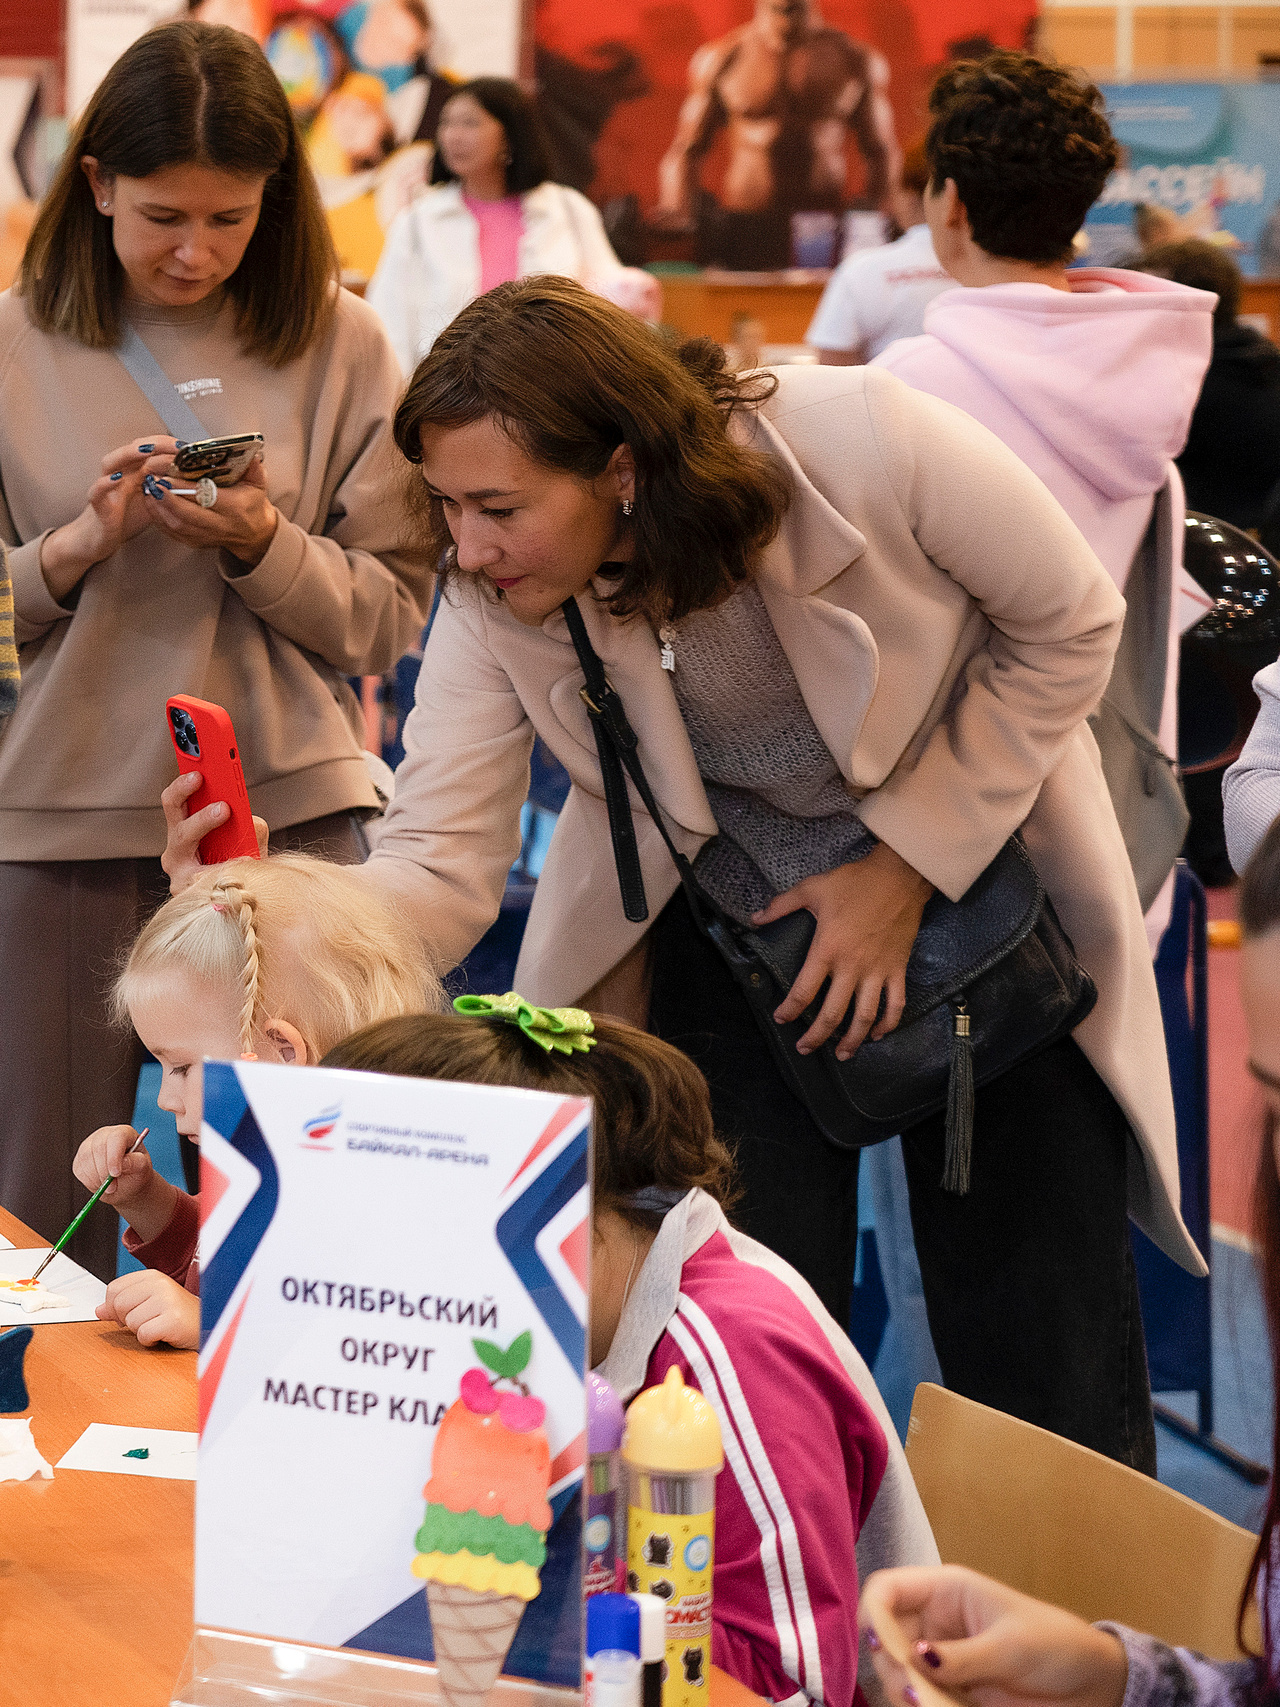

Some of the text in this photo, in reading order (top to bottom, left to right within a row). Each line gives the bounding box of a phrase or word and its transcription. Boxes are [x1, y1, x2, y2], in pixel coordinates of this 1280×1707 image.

[281, 1276, 499, 1330] ОКТЯБРЬСКИЙ
[340, 1336, 436, 1373] ОКРУГ
[263, 1376, 450, 1427] МАСТЕР КЛА
